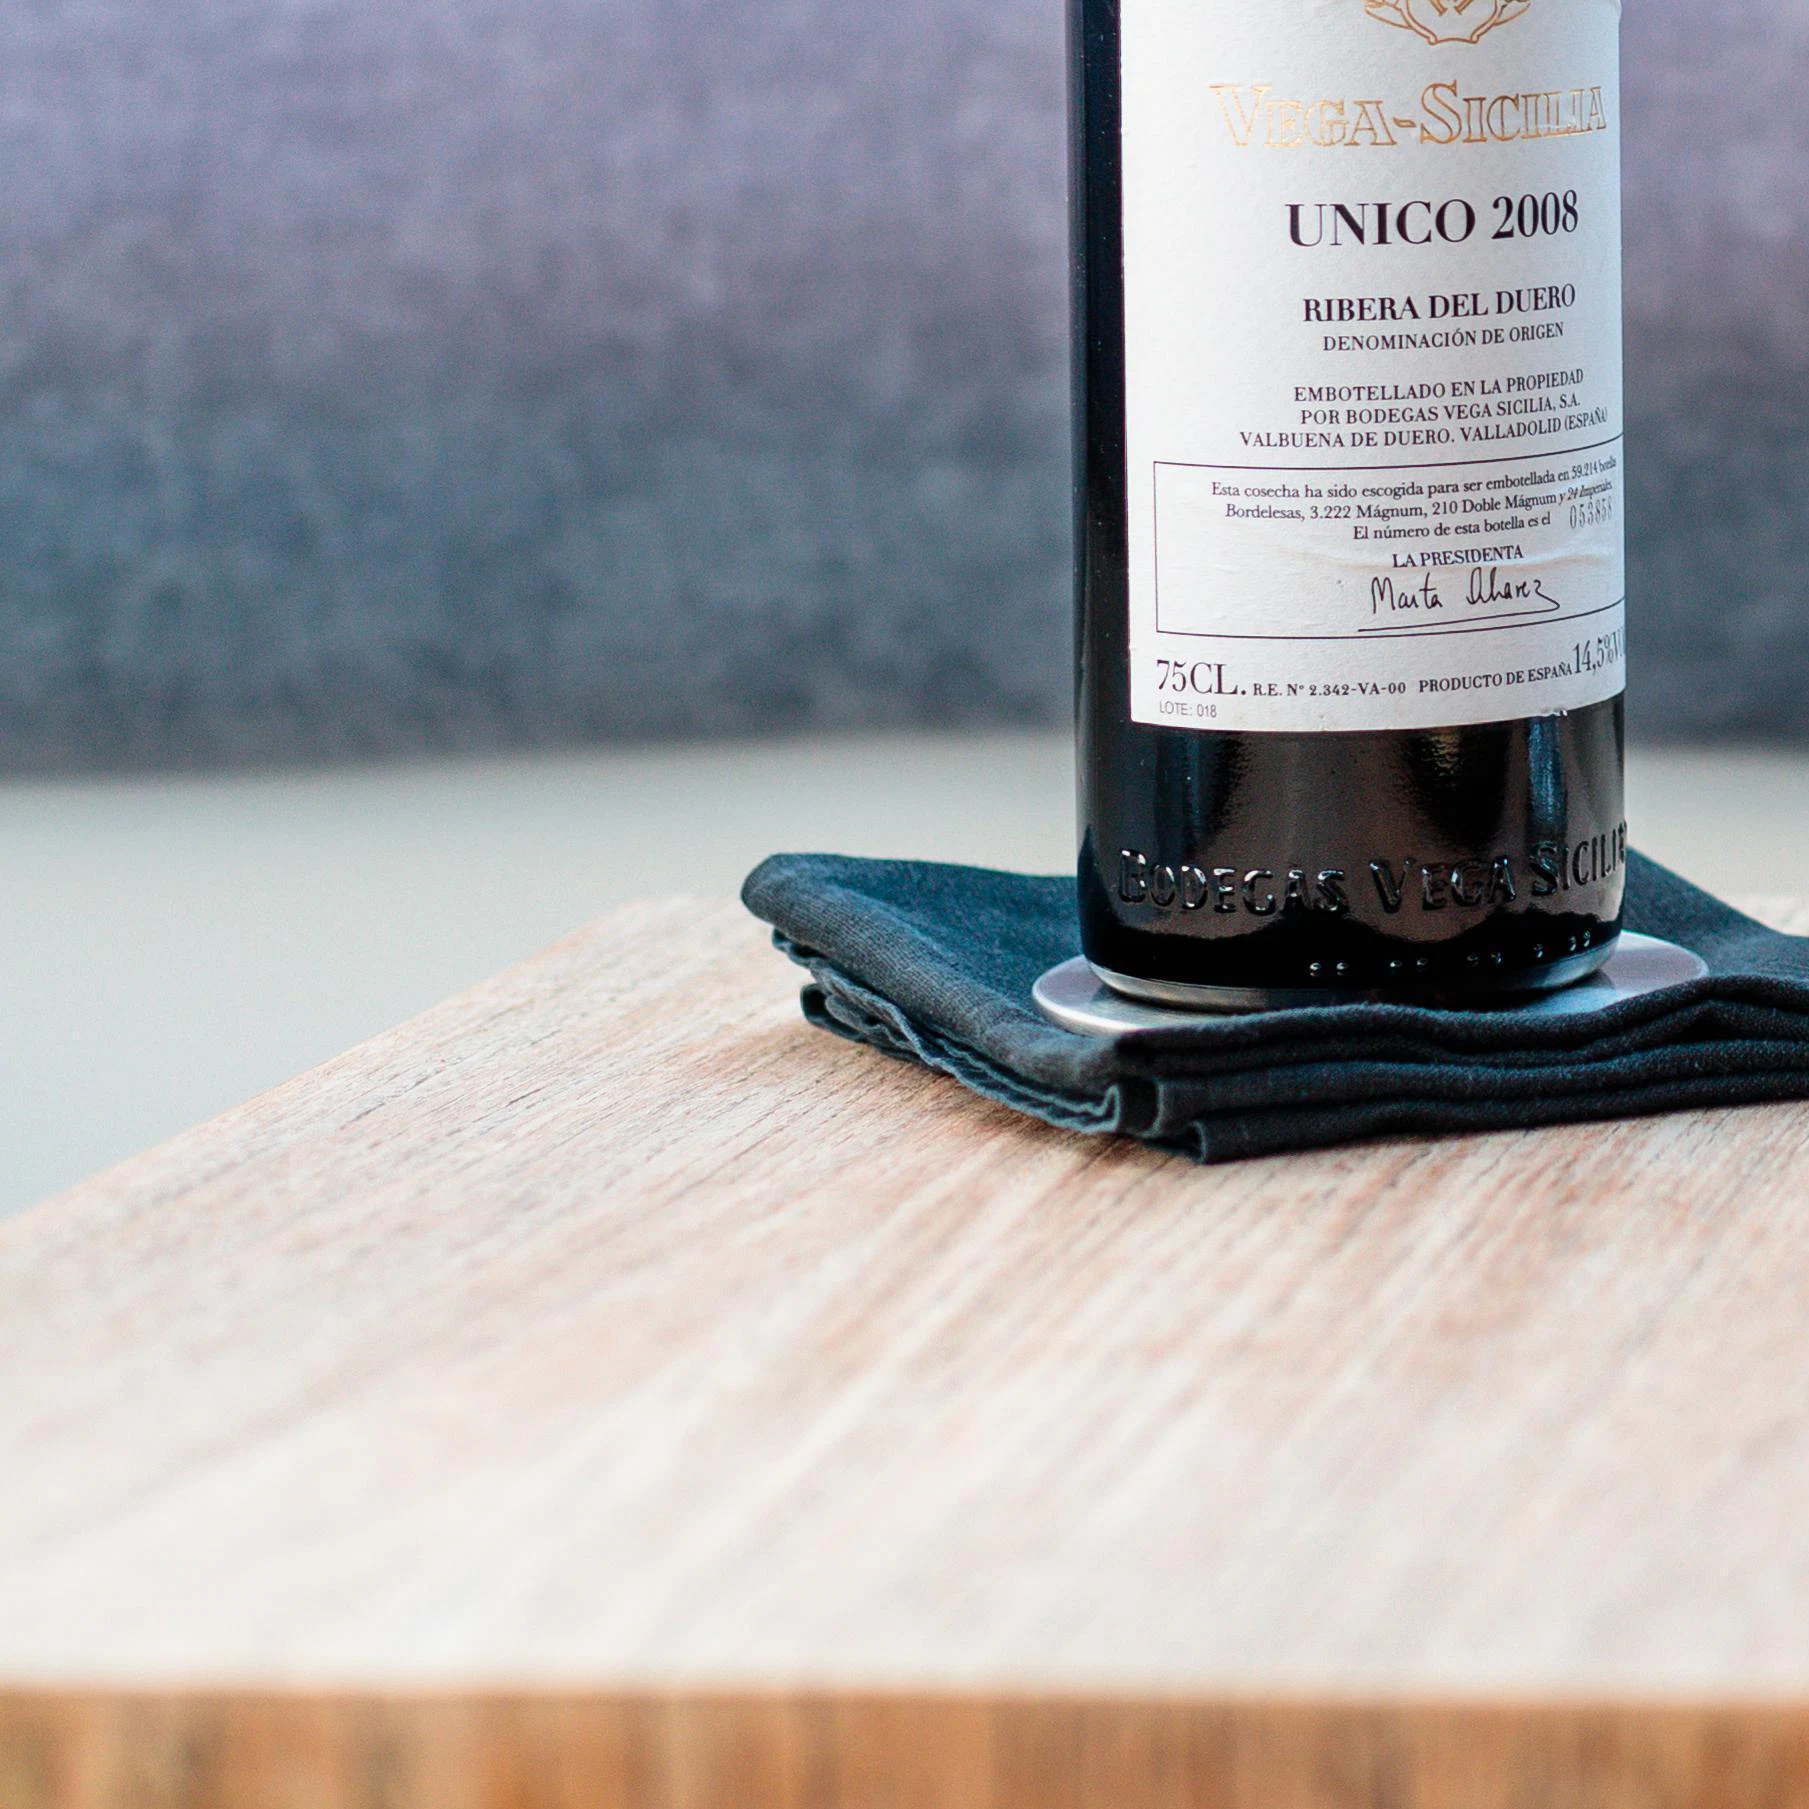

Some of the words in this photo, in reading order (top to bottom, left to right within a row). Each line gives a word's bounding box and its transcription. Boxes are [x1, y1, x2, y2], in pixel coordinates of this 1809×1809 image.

[1284, 199, 1475, 247] UNICO
[1491, 189, 1579, 239] 2008
[1303, 295, 1421, 322] RIBERA
[1429, 293, 1488, 318] DEL
[1496, 283, 1576, 315] DUERO
[1323, 328, 1476, 351] DENOMINACIÓN
[1482, 328, 1505, 344] DE
[1509, 321, 1564, 342] ORIGEN
[1294, 383, 1445, 402] EMBOTELLADO
[1451, 381, 1475, 397] EN
[1481, 379, 1502, 395] LA
[1506, 368, 1584, 393] PROPIEDAD
[1300, 409, 1340, 425] POR
[1346, 406, 1438, 424] BODEGAS
[1443, 403, 1492, 420] VEGA
[1496, 396, 1556, 416] SICILIA,
[1559, 393, 1580, 409] S.A.
[1240, 431, 1346, 448] VALBUENA
[1351, 432, 1378, 447] DE
[1460, 418, 1561, 442] VALLADOLID
[1211, 481, 1240, 496] Esta
[1244, 484, 1300, 498] cosecha
[1305, 484, 1323, 498] ha
[1327, 483, 1357, 498] sido
[1361, 482, 1423, 500] escogida
[1428, 481, 1459, 497] para
[1463, 480, 1483, 492] ser
[1486, 469, 1556, 490] embotellada
[1558, 471, 1570, 482] en
[1225, 504, 1305, 522] Bordelesas,
[1310, 506, 1351, 519] 3.222
[1357, 505, 1427, 522] Mágnum,
[1432, 502, 1458, 515] 210
[1462, 497, 1501, 514] Doble
[1505, 494, 1557, 511] Mágnum
[1558, 494, 1567, 506] y
[1353, 526, 1368, 540] El
[1373, 525, 1430, 539] número
[1434, 522, 1451, 536] de
[1454, 523, 1480, 535] esta
[1484, 517, 1525, 533] botella
[1528, 517, 1539, 528] es
[1392, 553, 1416, 568] LA
[1420, 545, 1524, 567] PRESIDENTA
[1252, 683, 1283, 696] R.E.
[1309, 682, 1406, 696] 2.342-VA-00
[1419, 673, 1503, 693] PRODUCTO
[1506, 671, 1525, 685] DE
[1528, 662, 1573, 681] ESPAÑA
[1159, 701, 1193, 716] LOTE:
[1196, 703, 1217, 718] 018
[1118, 847, 1350, 916] BODEGAS
[1369, 856, 1516, 913] VEGA
